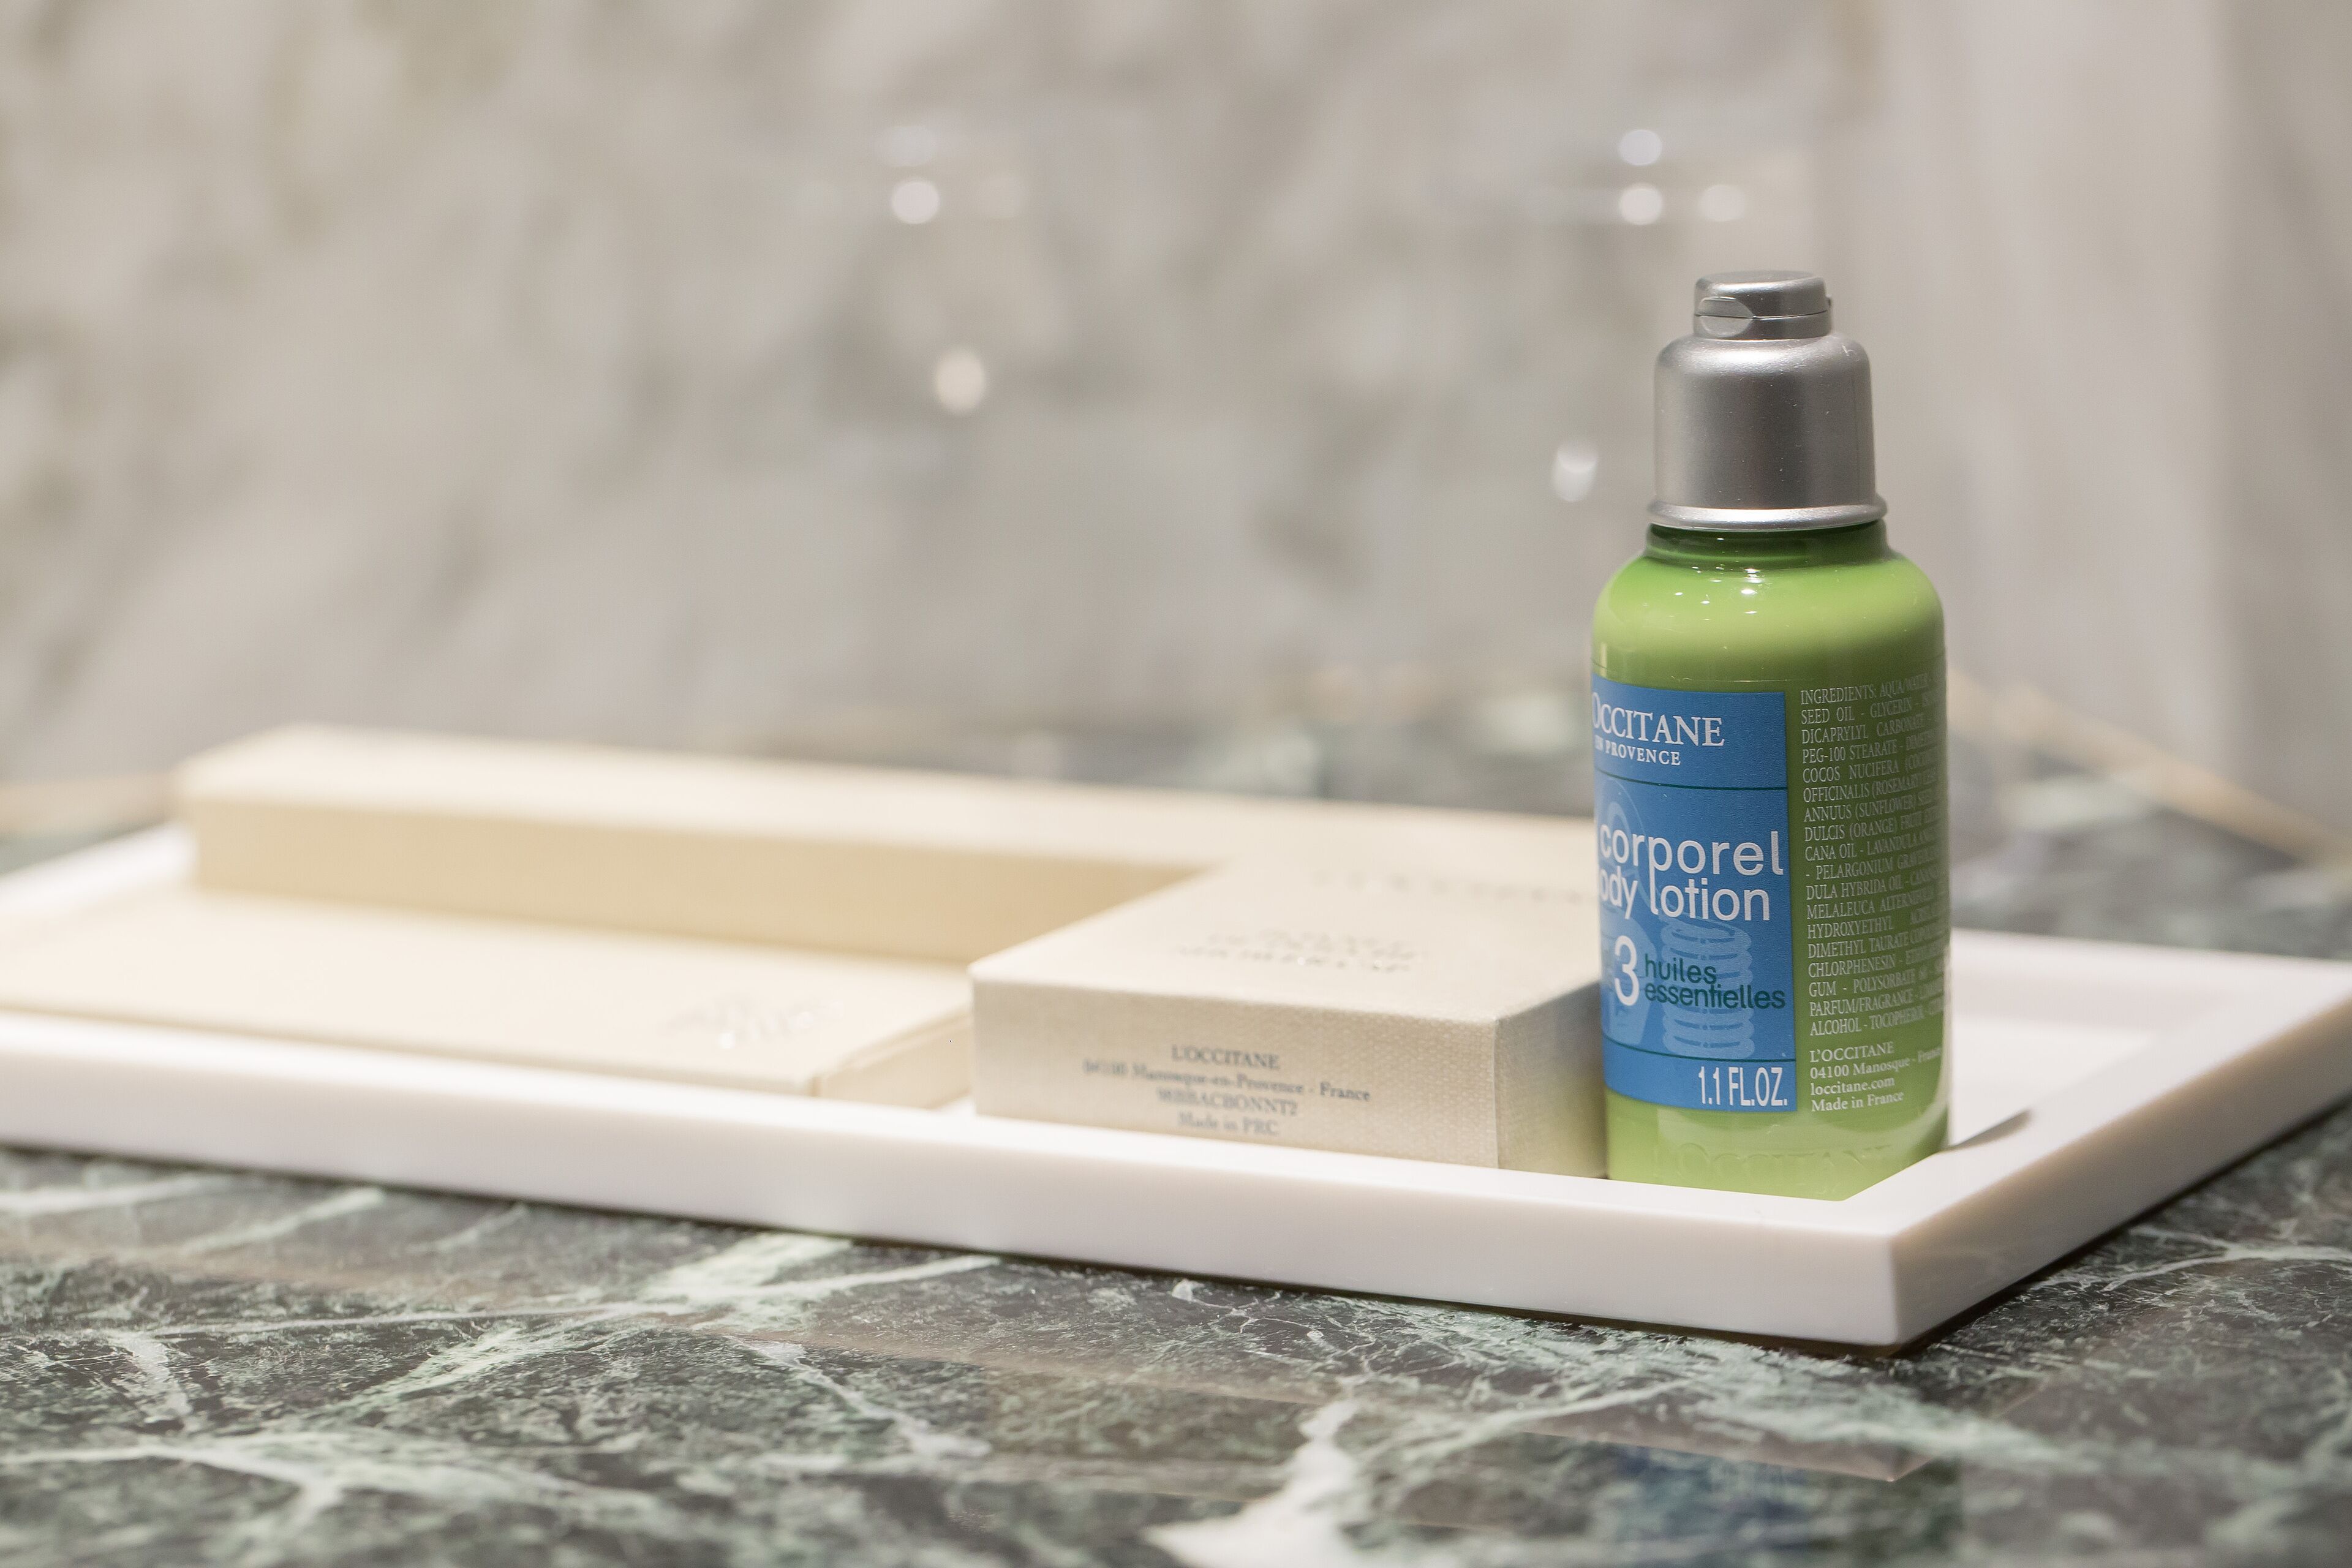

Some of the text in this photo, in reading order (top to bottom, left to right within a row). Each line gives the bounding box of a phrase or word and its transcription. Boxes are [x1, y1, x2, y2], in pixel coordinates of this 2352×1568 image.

[1801, 684, 1877, 705] INGREDIENTS:
[1801, 708, 1830, 725] SEED
[1836, 706, 1855, 722] OIL
[1801, 725, 1868, 744] DICAPRYLYL
[1605, 742, 1681, 766] PROVENCE
[1803, 747, 1846, 764] PEG-100
[1850, 739, 1898, 760] STEARATE
[1803, 766, 1841, 783] COCOS
[1849, 760, 1900, 780] NUCIFERA
[1803, 783, 1869, 802] OFFICINALIS
[1804, 804, 1852, 822] ANNUUS
[1804, 824, 1845, 842] DULCIS
[1849, 816, 1898, 840] (ORANGE)
[1600, 824, 1784, 883] corporel
[1805, 845, 1836, 861] CANA
[1839, 843, 1858, 858] OIL
[1816, 857, 1893, 880] PELARGONIUM
[1649, 872, 1770, 921] lotion
[1806, 884, 1838, 900] DULA
[1841, 878, 1887, 897] HYBRIDA
[1807, 899, 1875, 919] MELALEUCA
[1807, 916, 1894, 939] HYDROXYETHYL
[1808, 939, 1866, 959] DIMETHYL
[1869, 931, 1909, 952] TAURATE
[1614, 935, 1717, 1006] 3 huiles
[1808, 953, 1896, 978] CHLORPHENESIN
[1645, 982, 1786, 1009] essentielles
[1809, 981, 1836, 997] GUM
[1810, 1017, 1862, 1036] ALCOHOL
[1810, 1041, 1894, 1063] L'OCCITANE
[1810, 1065, 1849, 1079] 04100
[1853, 1057, 1910, 1076] Manosque
[1320, 1082, 1371, 1102] France
[1698, 1066, 1721, 1106] 1.1
[1811, 1077, 1895, 1096] loccitane.com
[1811, 1091, 1904, 1112] Made in France
